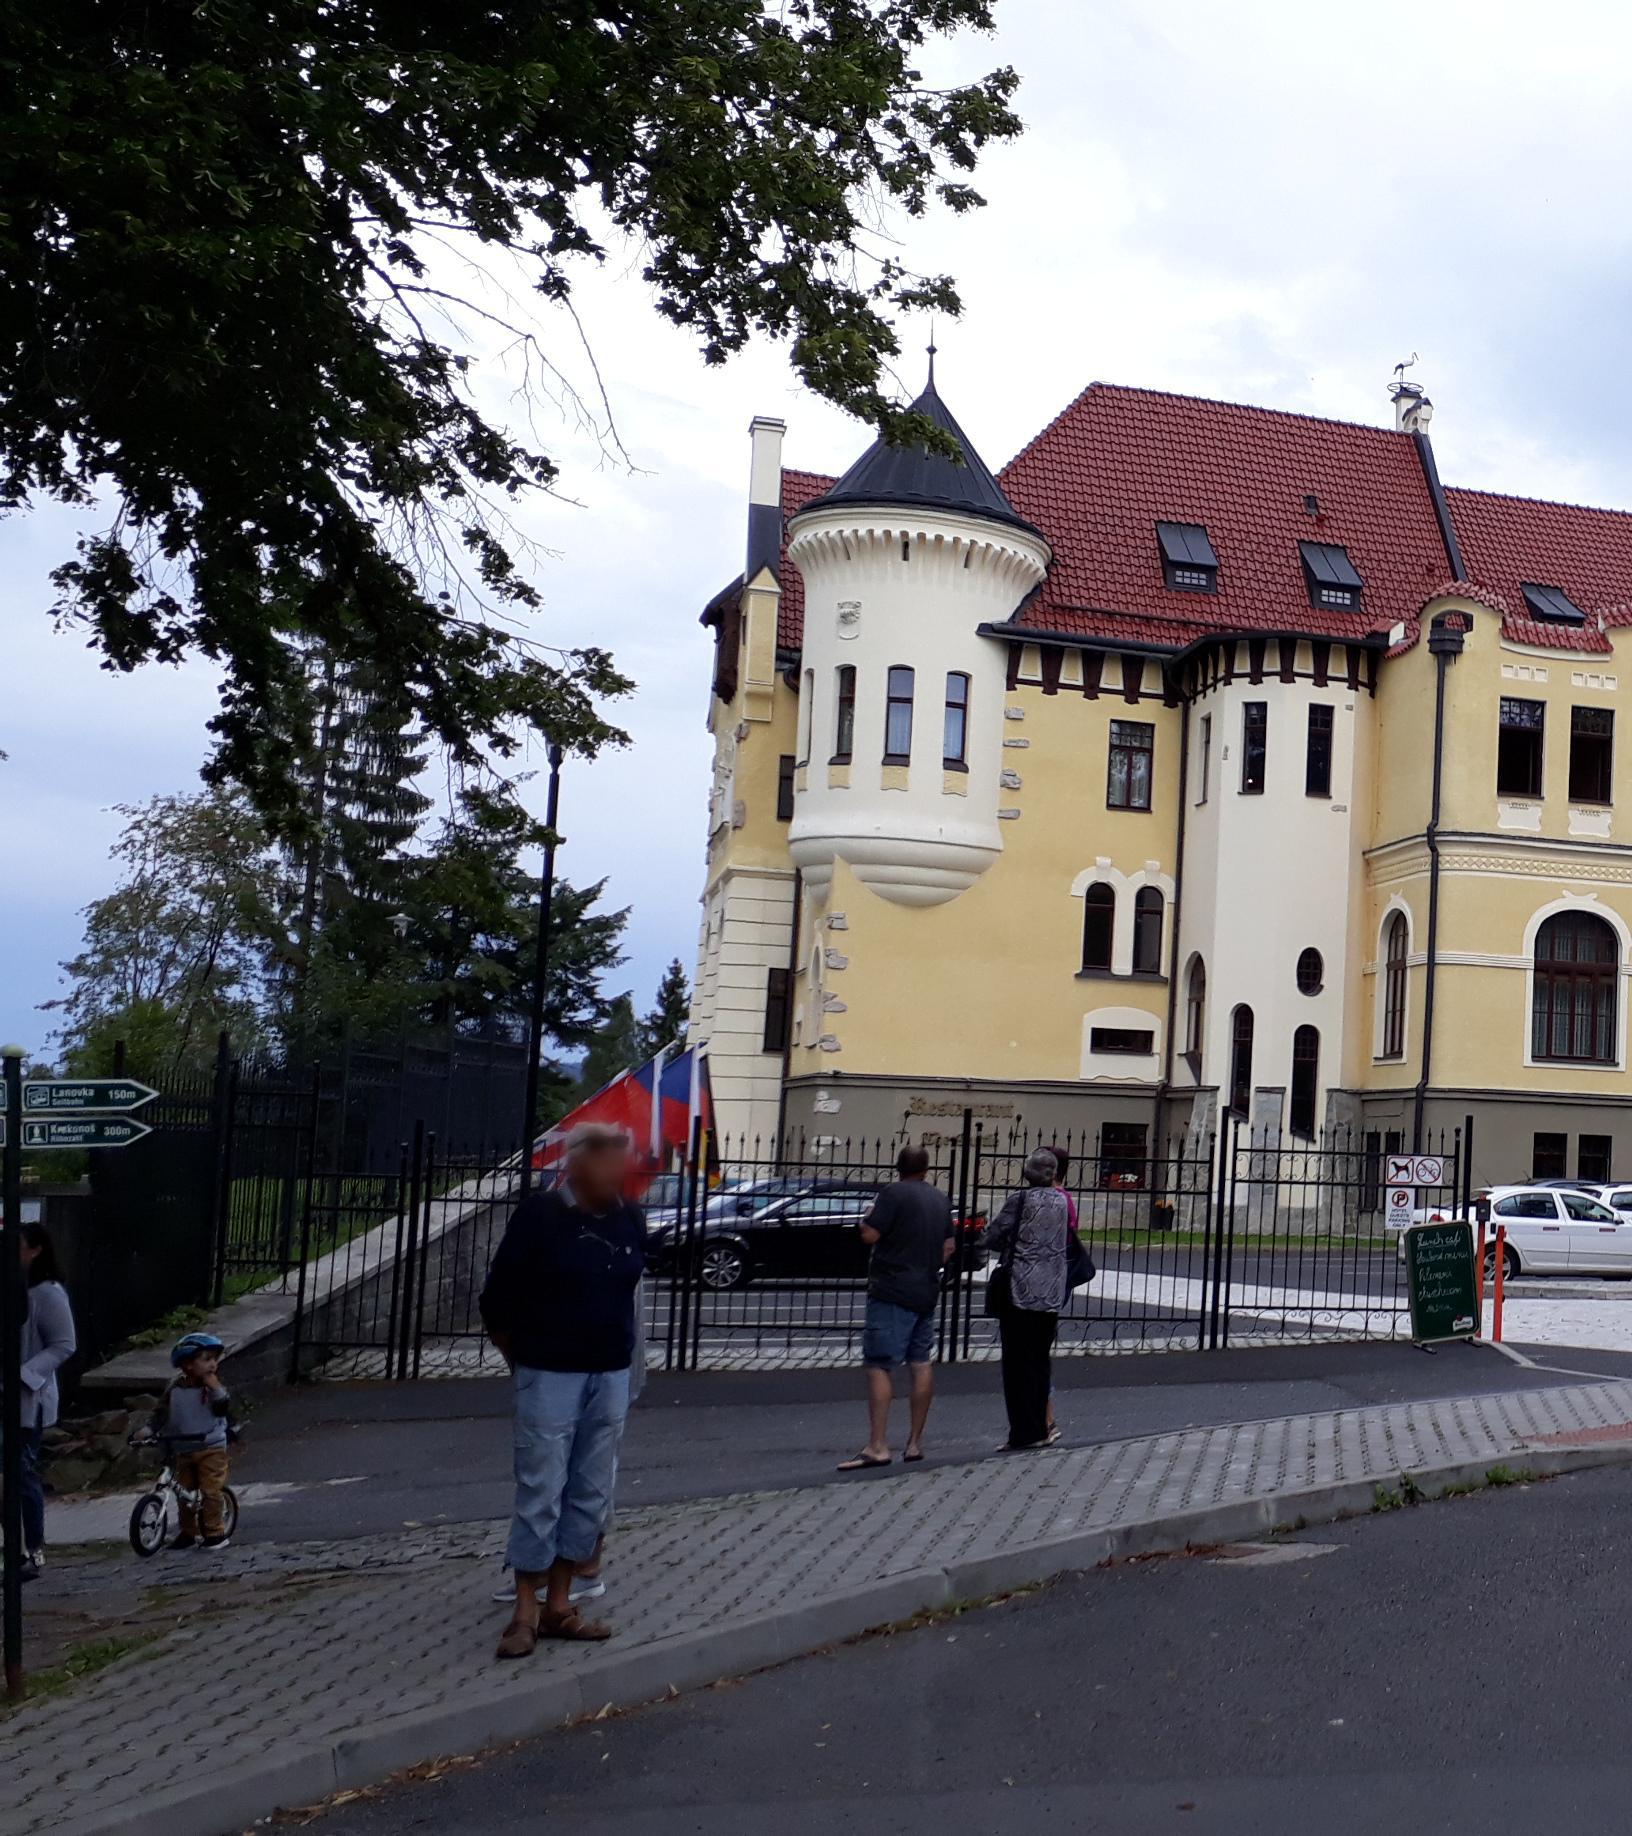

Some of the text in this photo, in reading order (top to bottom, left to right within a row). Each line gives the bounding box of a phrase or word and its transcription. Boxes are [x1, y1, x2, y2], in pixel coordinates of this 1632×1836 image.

[52, 1088, 136, 1099] Lanovka 150m
[103, 1126, 131, 1136] 300m
